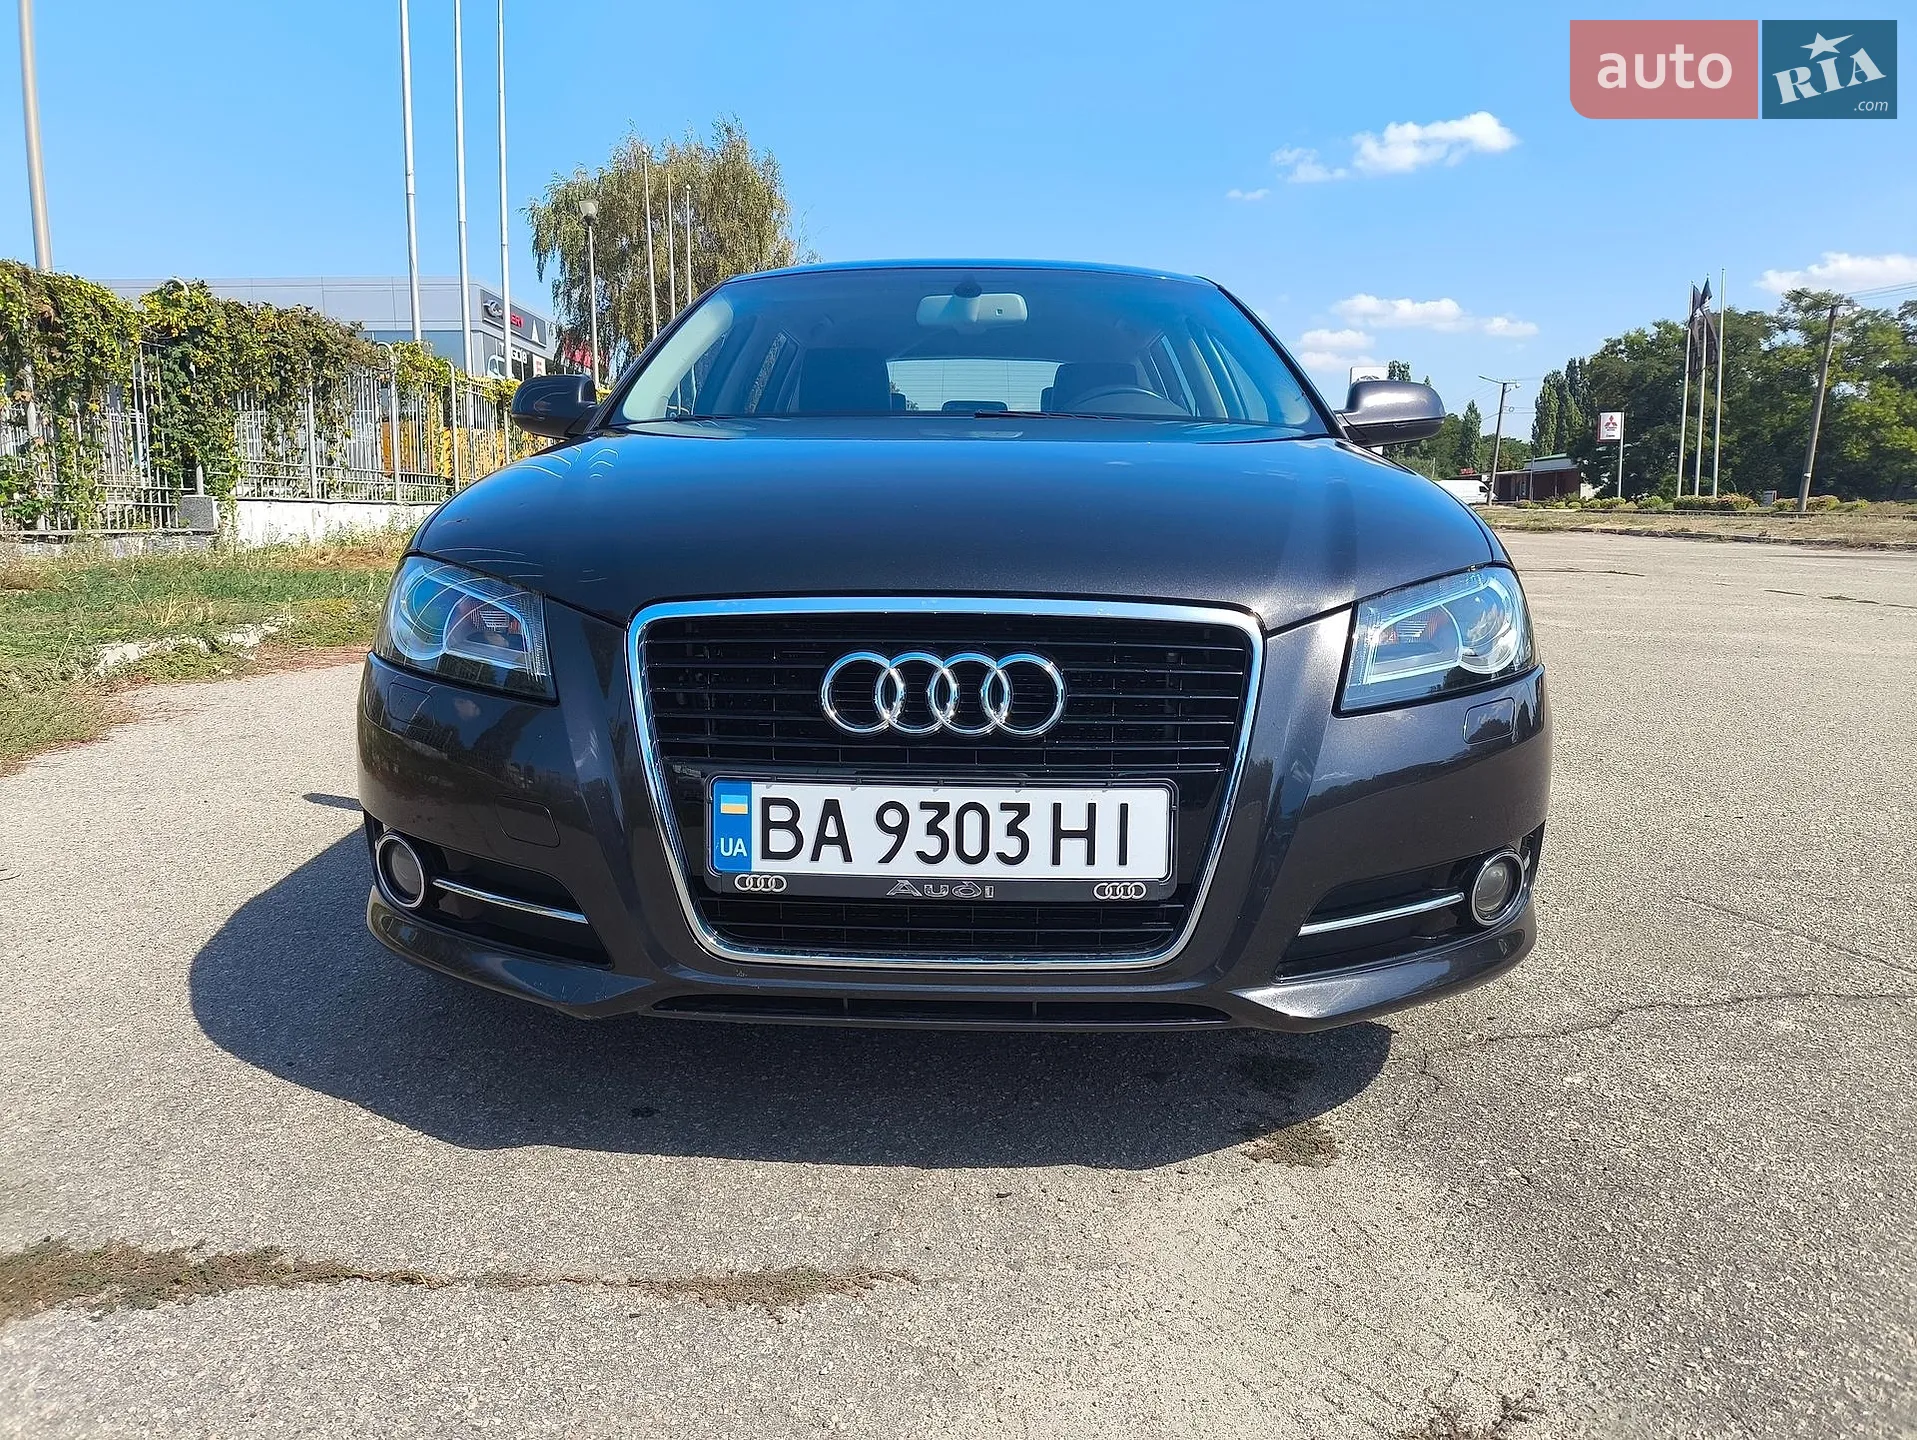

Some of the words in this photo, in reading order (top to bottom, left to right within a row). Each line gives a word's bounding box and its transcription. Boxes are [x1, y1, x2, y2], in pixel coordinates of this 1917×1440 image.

[720, 837, 748, 857] UA
[761, 797, 853, 863] BA
[875, 800, 1031, 866] 9303
[1051, 802, 1129, 866] HI
